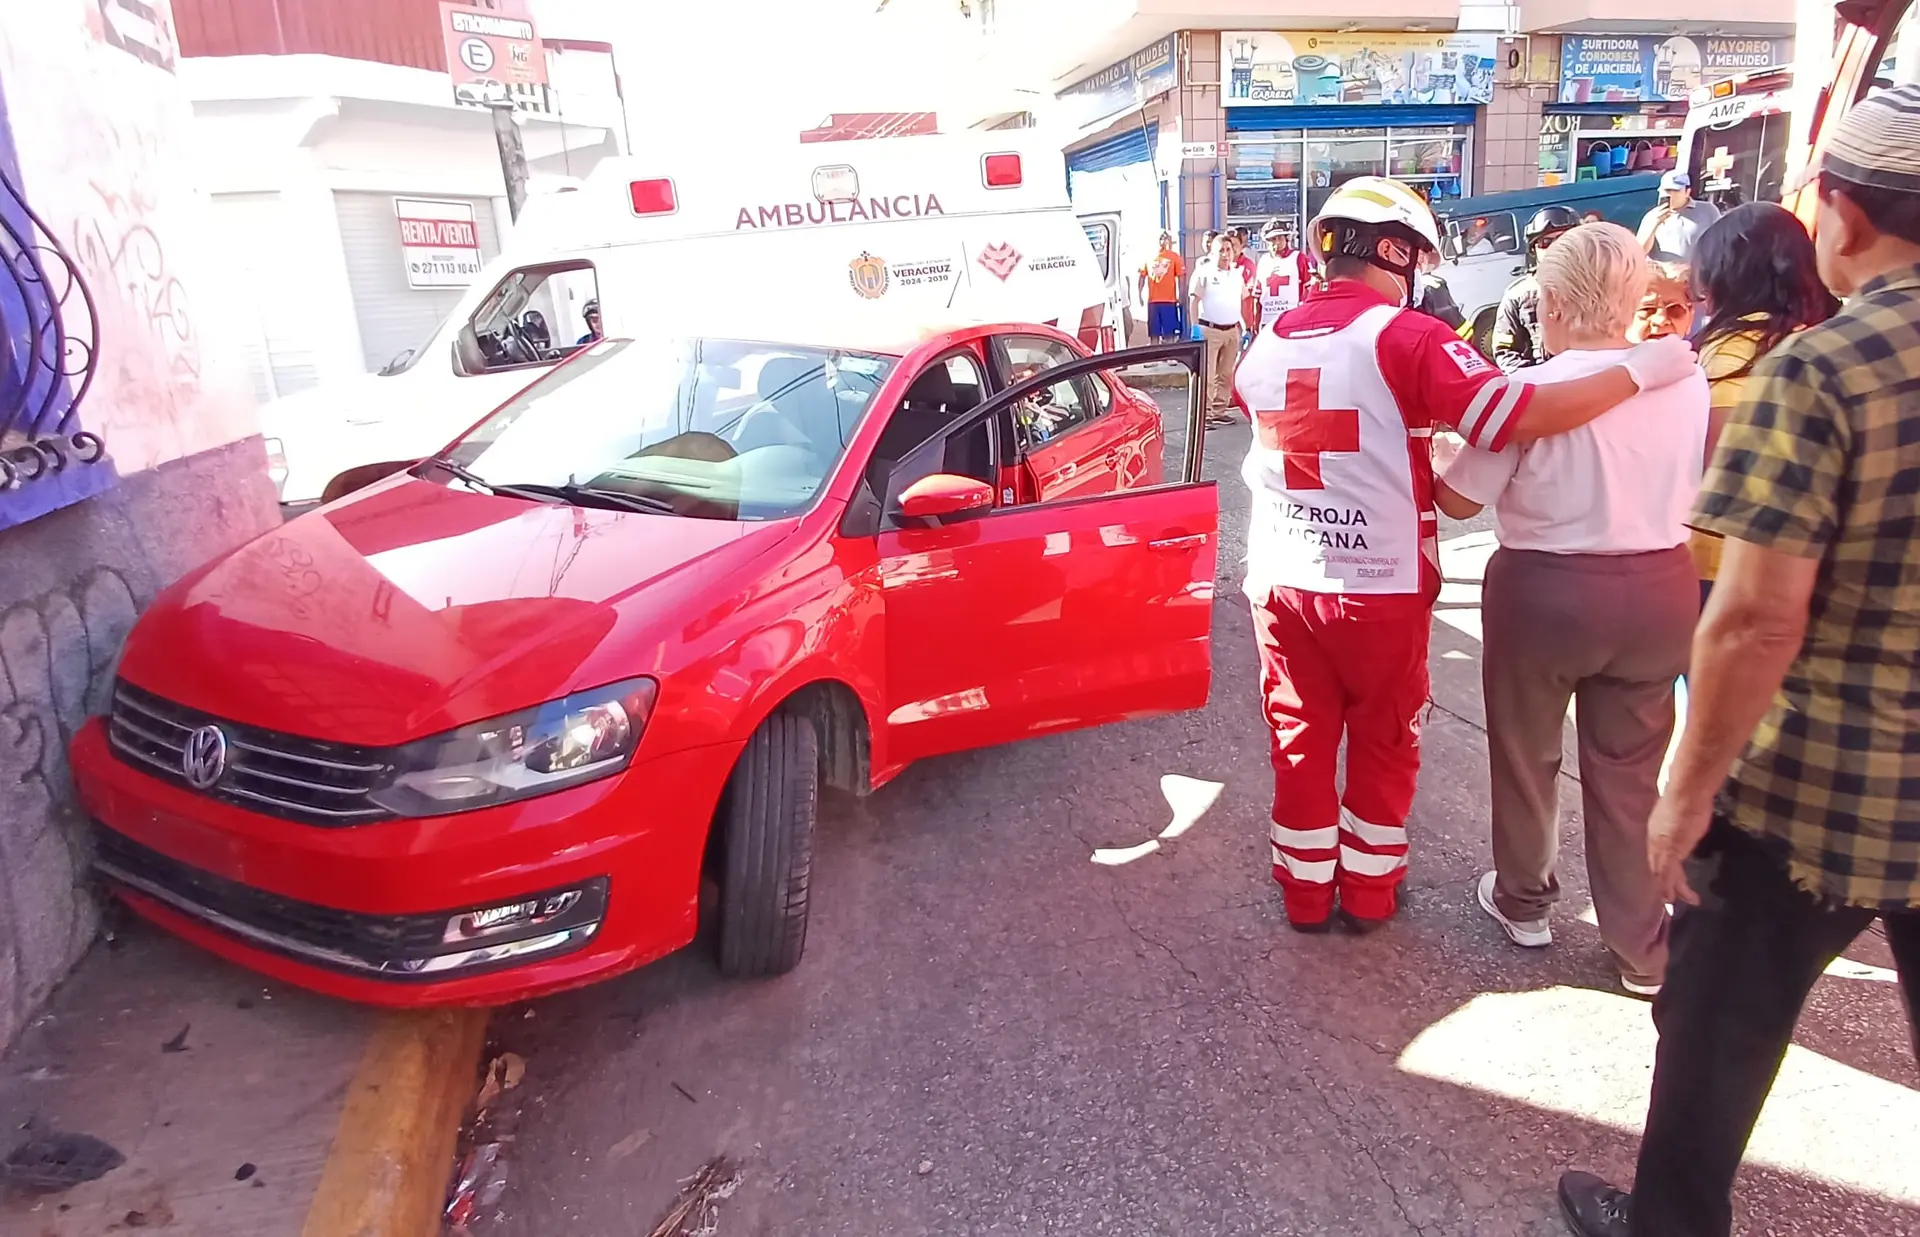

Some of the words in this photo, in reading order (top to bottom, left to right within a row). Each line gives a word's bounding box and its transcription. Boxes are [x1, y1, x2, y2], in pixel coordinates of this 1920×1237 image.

[1581, 39, 1639, 50] SURTIDORA
[1707, 40, 1770, 53] MAYOREO
[468, 44, 487, 66] E
[1580, 51, 1640, 61] CORDOBESA
[1706, 54, 1715, 66] Y
[1716, 54, 1769, 66] MENUDEO
[1575, 63, 1589, 74] DE
[1590, 60, 1642, 74] JARCIERÍA
[1084, 65, 1119, 92] MAYOREO
[1121, 63, 1127, 75] Y
[1252, 89, 1293, 100] CABRERA
[736, 193, 945, 230] AMBULANCIA
[401, 220, 475, 246] RENTA/VENTA
[421, 262, 438, 274] 271
[440, 263, 455, 274] 113
[893, 264, 952, 278] VERACRUZ
[1028, 260, 1076, 272] VERACRUZ
[900, 277, 921, 286] 2024
[928, 274, 949, 283] 2030
[1309, 506, 1368, 527] ROJA
